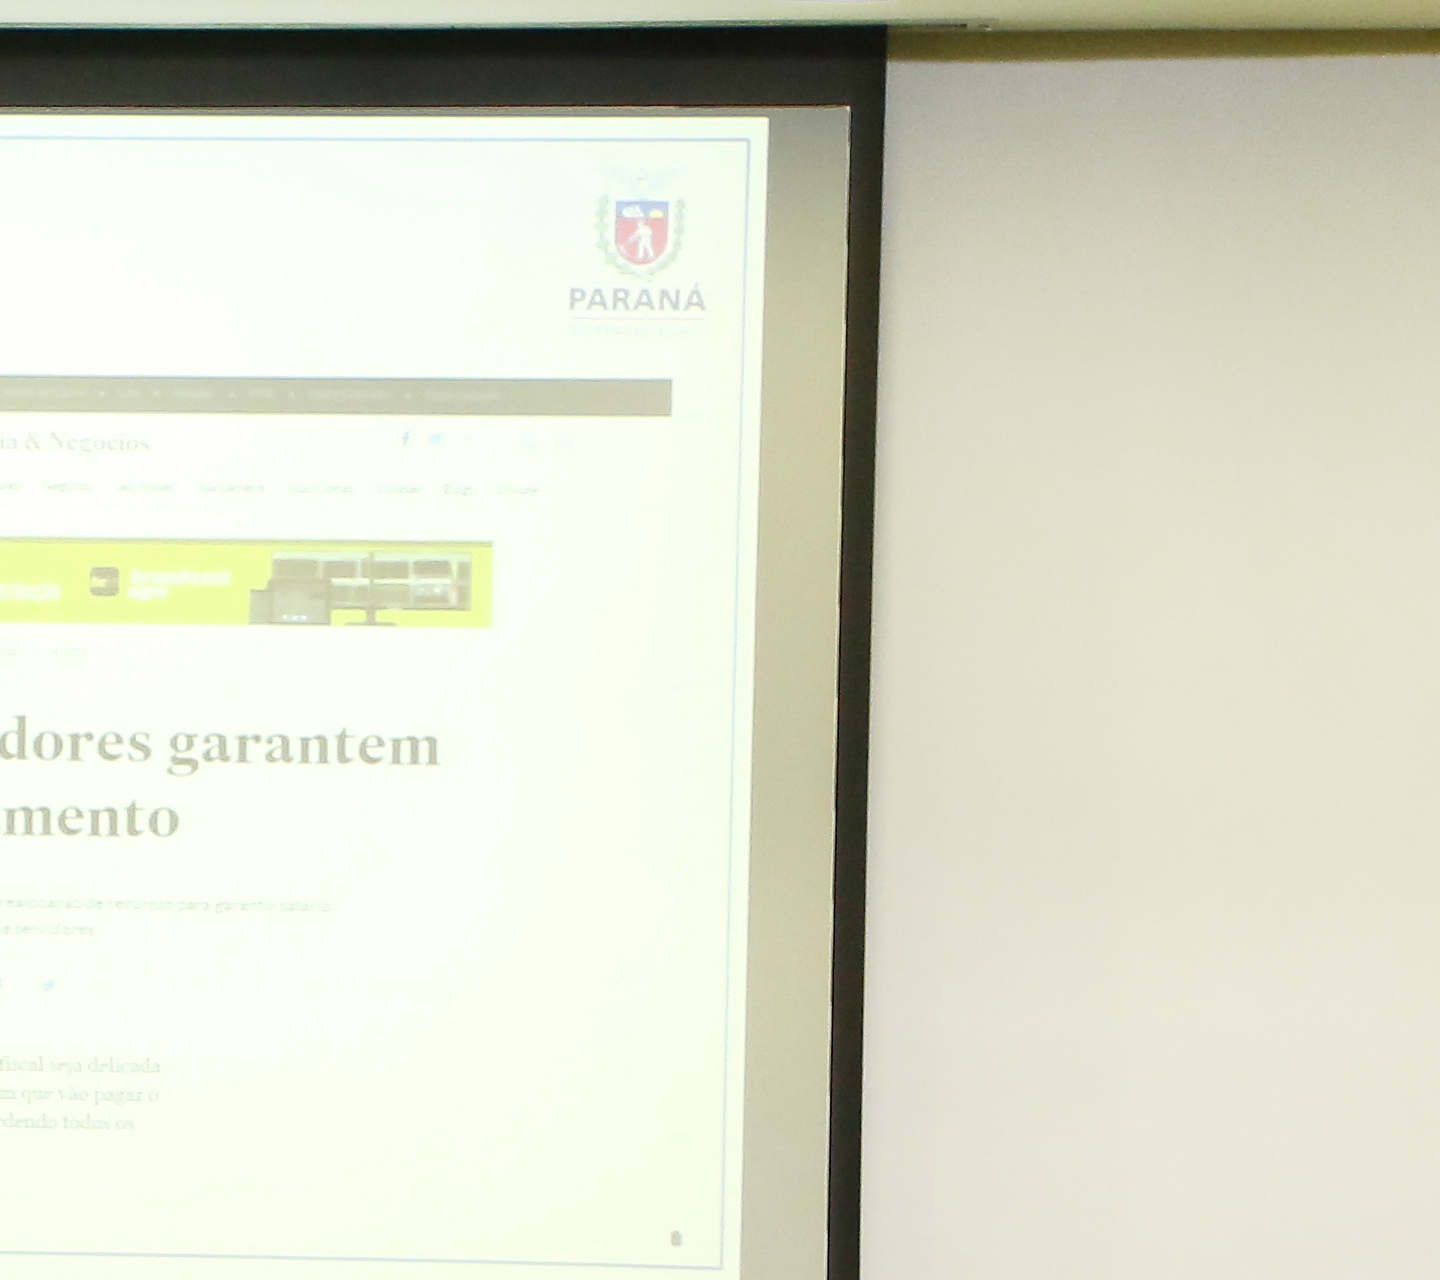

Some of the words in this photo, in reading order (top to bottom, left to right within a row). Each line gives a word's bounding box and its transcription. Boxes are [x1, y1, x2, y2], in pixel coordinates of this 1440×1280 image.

[569, 282, 707, 311] PARANÁ
[24, 432, 42, 451] &
[166, 727, 441, 777] garantem
[87, 1056, 161, 1074] delicada
[94, 1089, 144, 1106] pagar
[62, 1113, 111, 1130] todos
